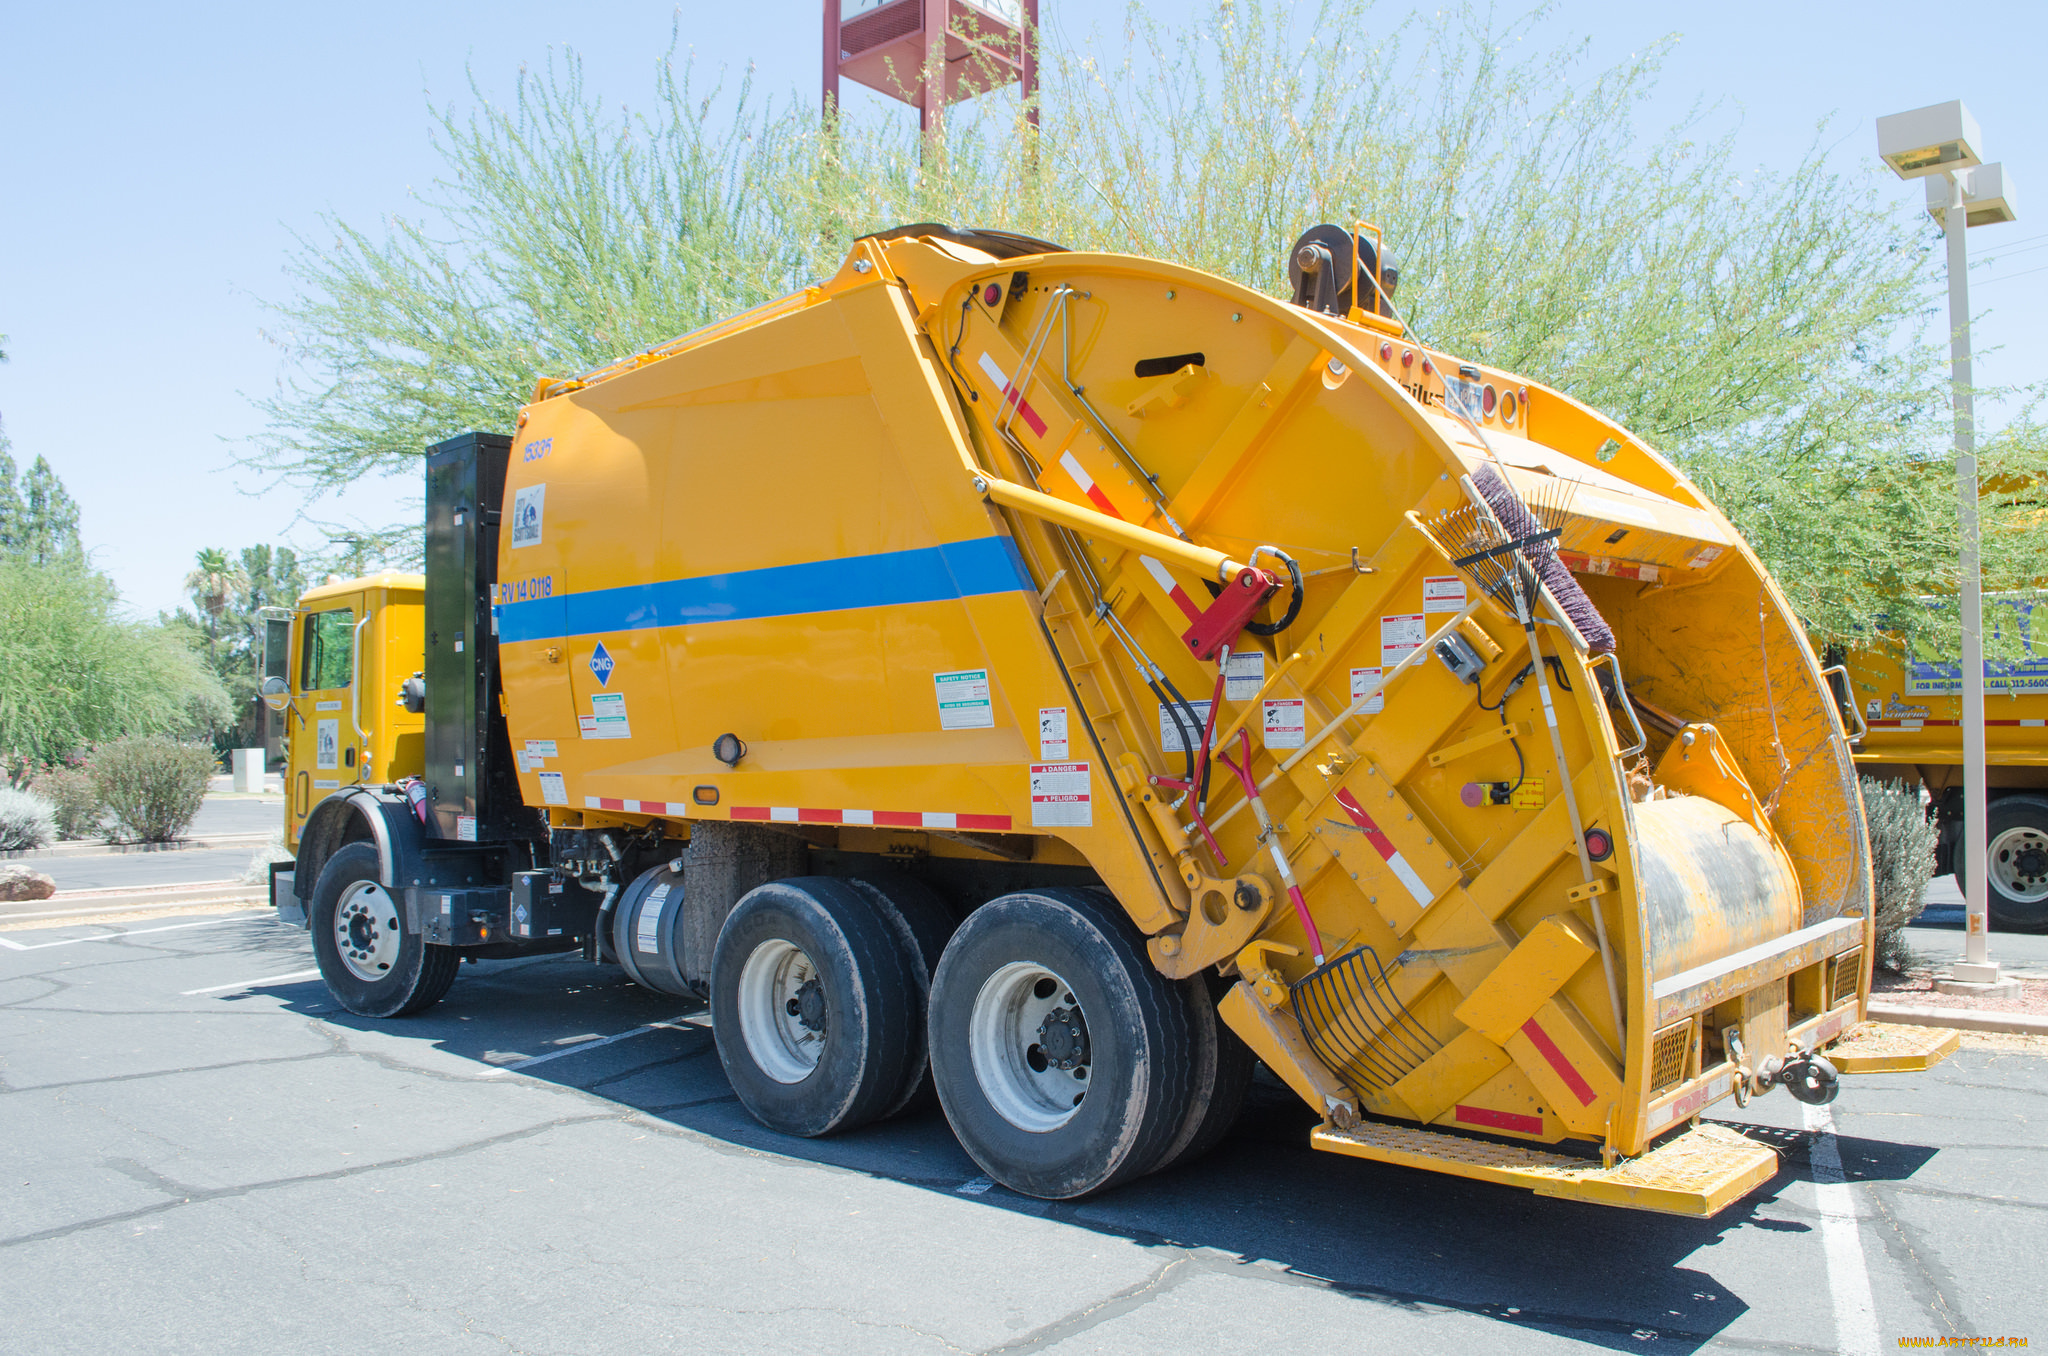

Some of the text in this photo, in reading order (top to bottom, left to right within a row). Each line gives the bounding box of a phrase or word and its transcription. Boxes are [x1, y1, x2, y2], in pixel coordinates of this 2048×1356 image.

[502, 575, 552, 603] RV 14 0118
[591, 657, 612, 671] CNG
[1990, 679, 2008, 688] CALL
[1048, 765, 1077, 773] DANGER
